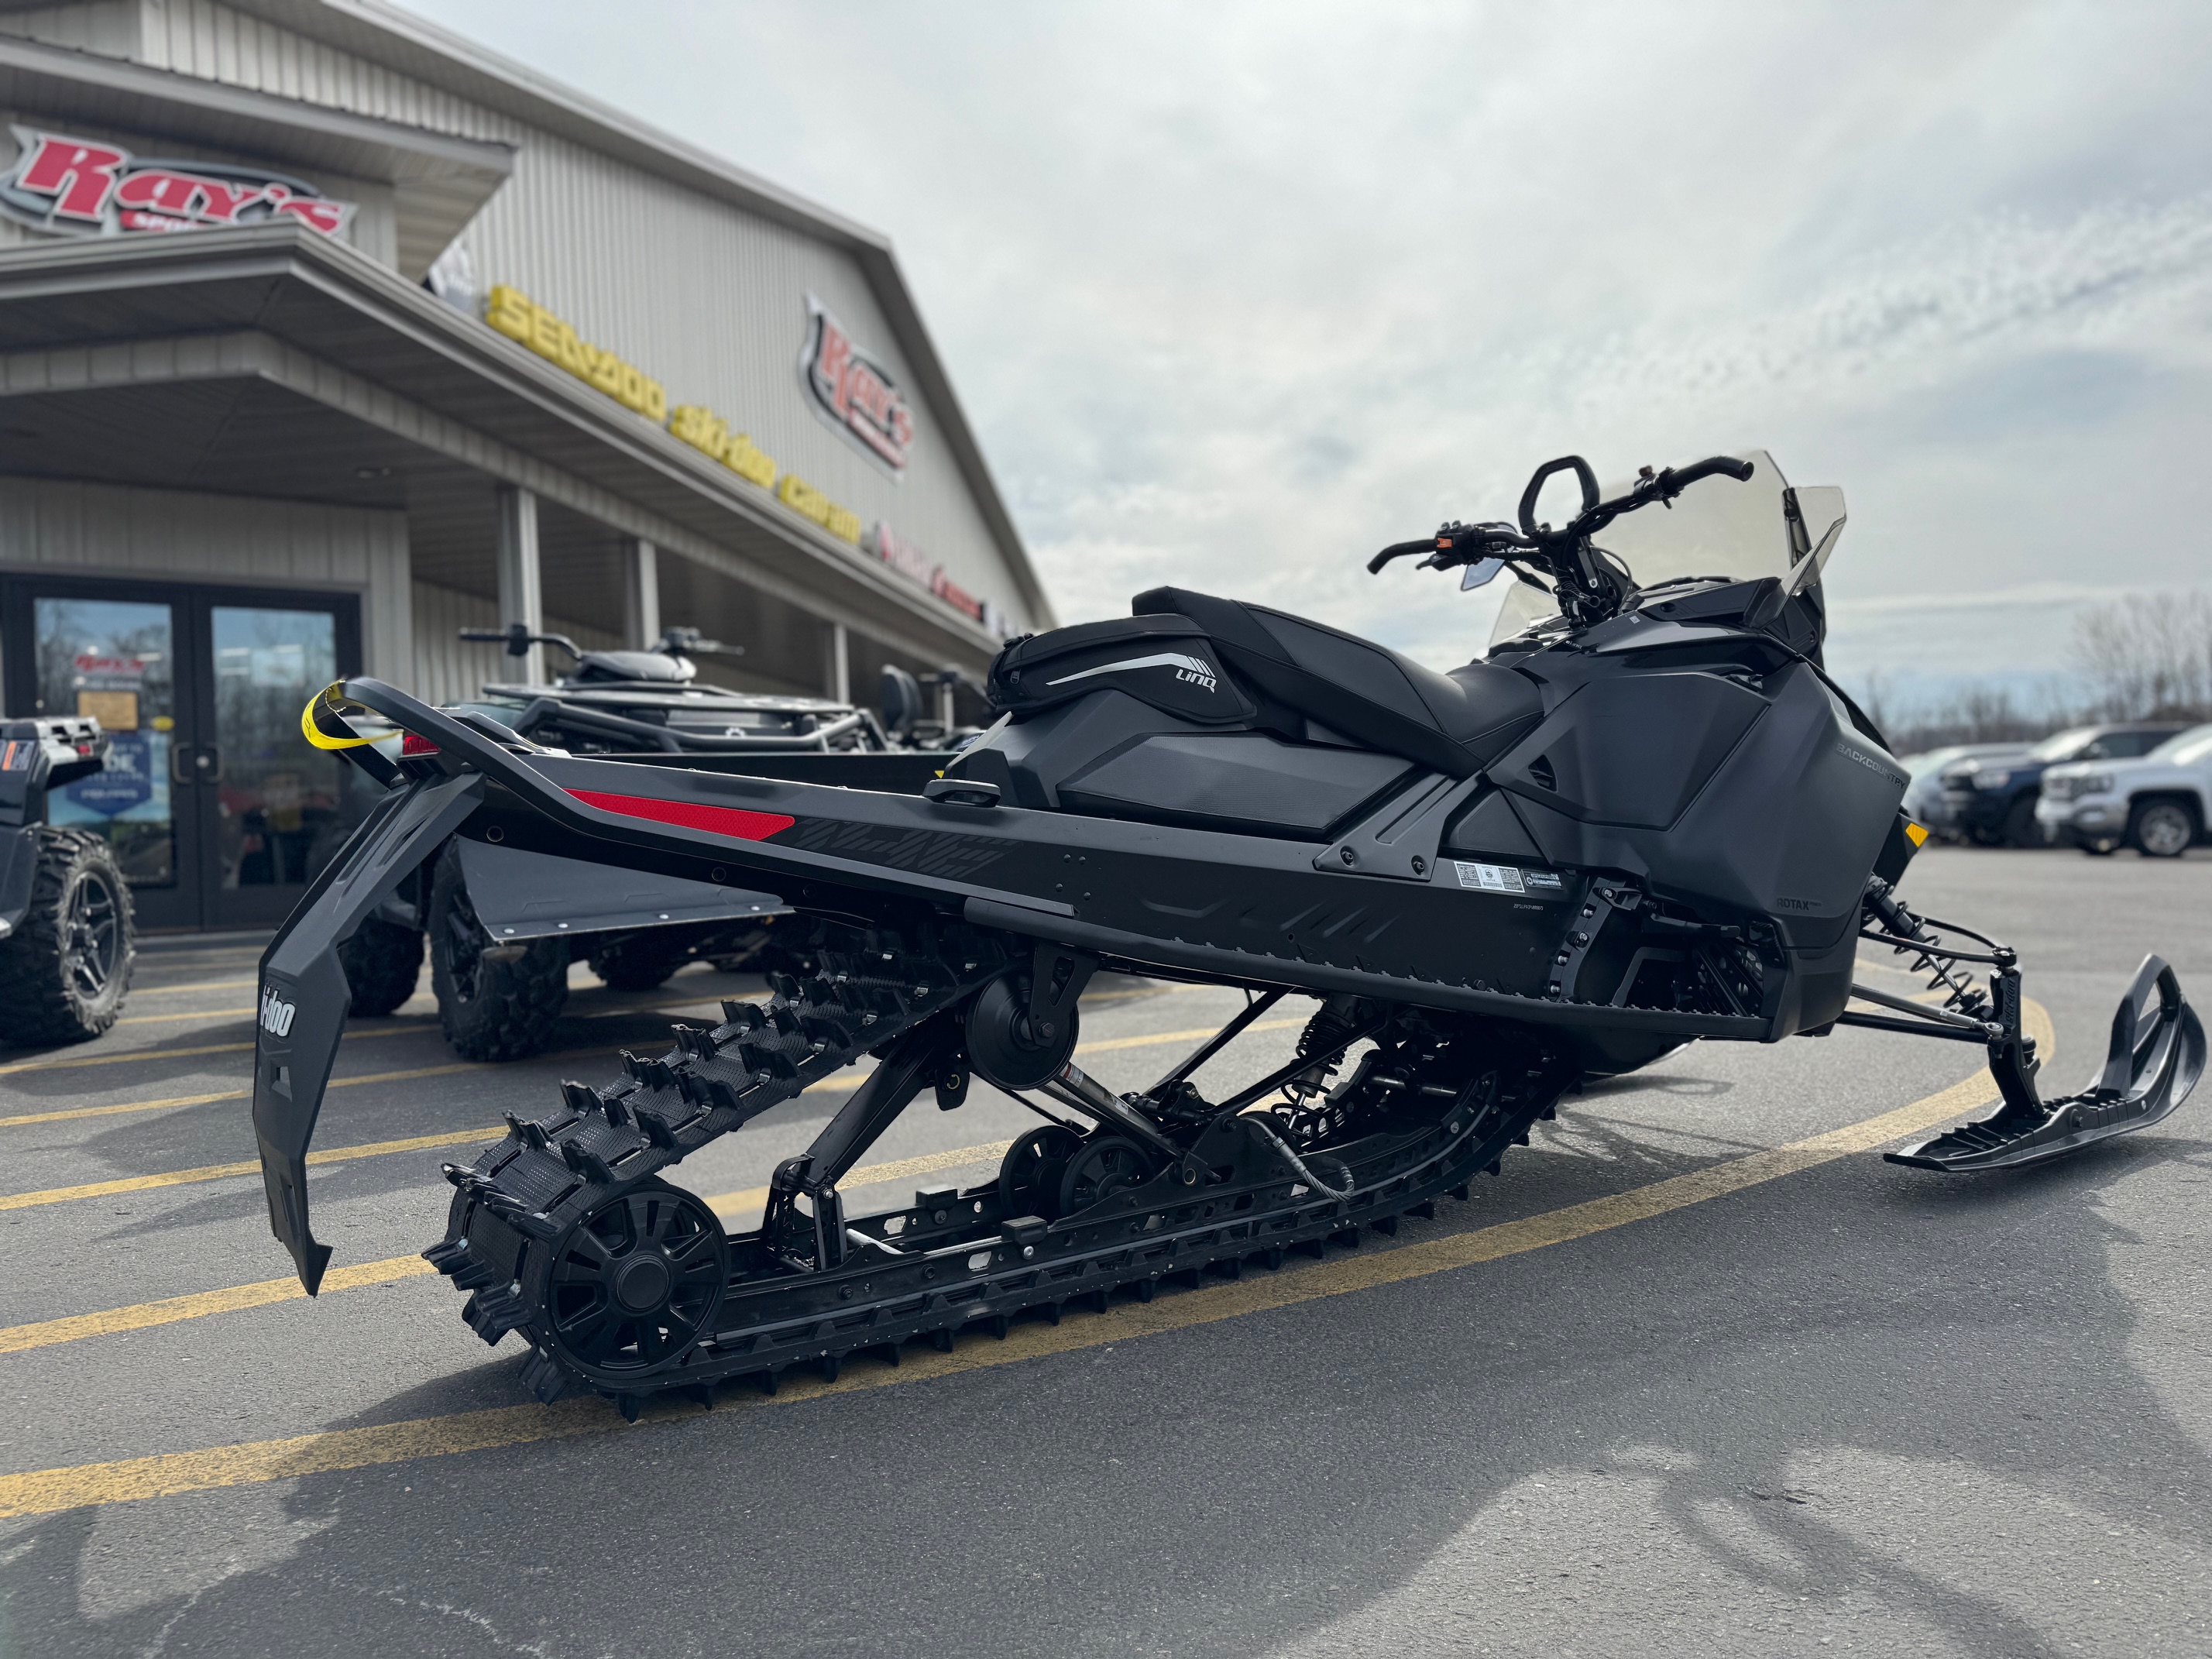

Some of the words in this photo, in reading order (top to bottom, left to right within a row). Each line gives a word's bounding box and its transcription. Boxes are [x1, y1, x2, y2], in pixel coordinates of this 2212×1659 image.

[19, 135, 342, 233] Ray's
[1836, 743, 1905, 789] BACKCOUNTRY
[1777, 898, 1809, 911] ROTAX
